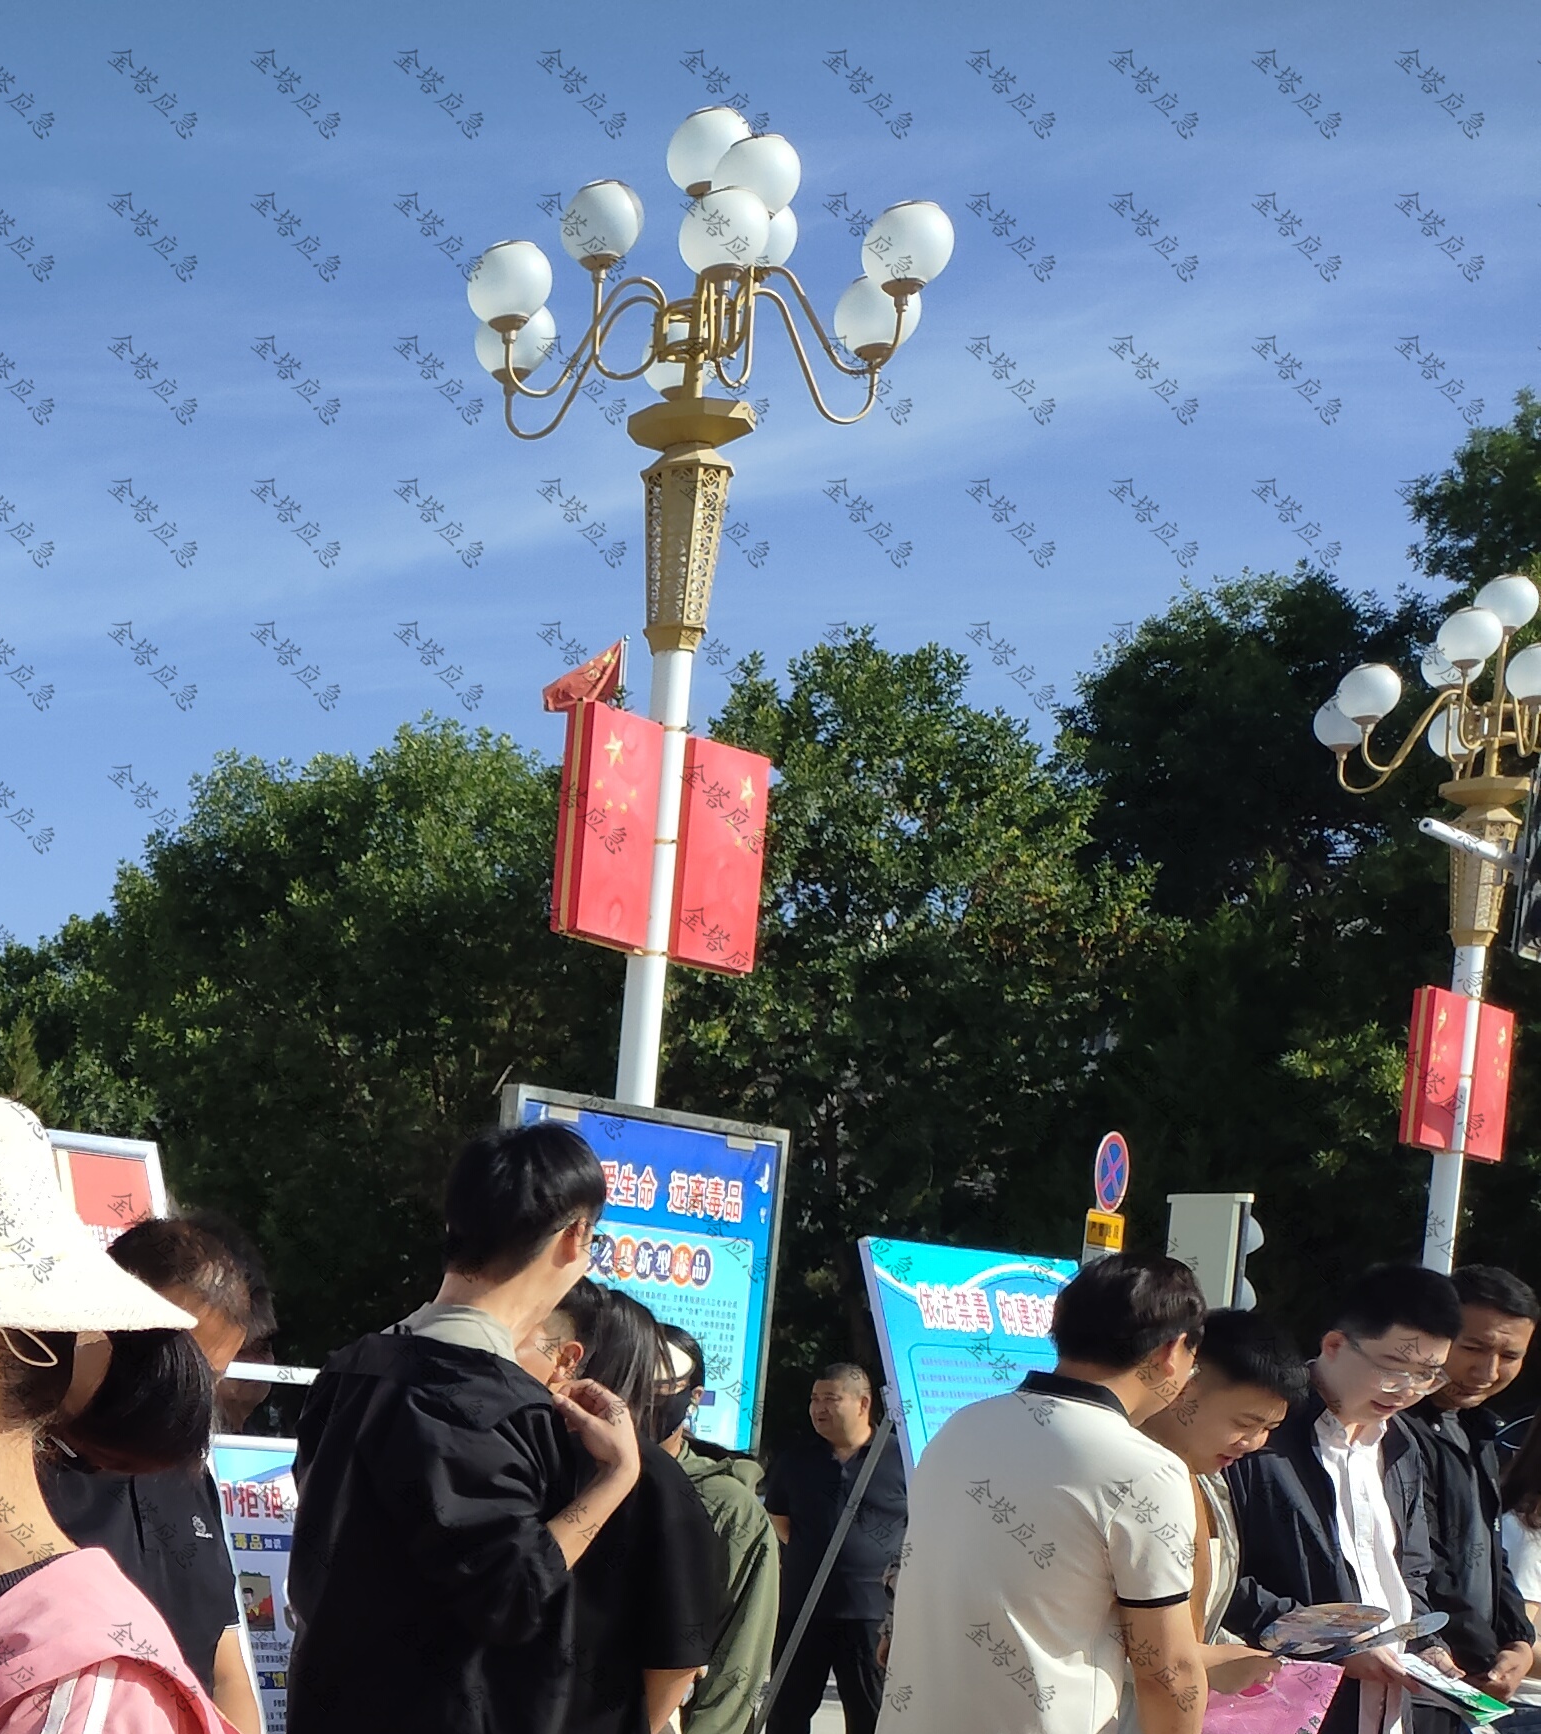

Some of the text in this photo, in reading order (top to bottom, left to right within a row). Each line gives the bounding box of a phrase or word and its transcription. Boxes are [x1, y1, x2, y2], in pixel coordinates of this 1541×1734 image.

[667, 1170, 743, 1223] 远离毒品
[916, 1282, 993, 1334] 依法禁毒
